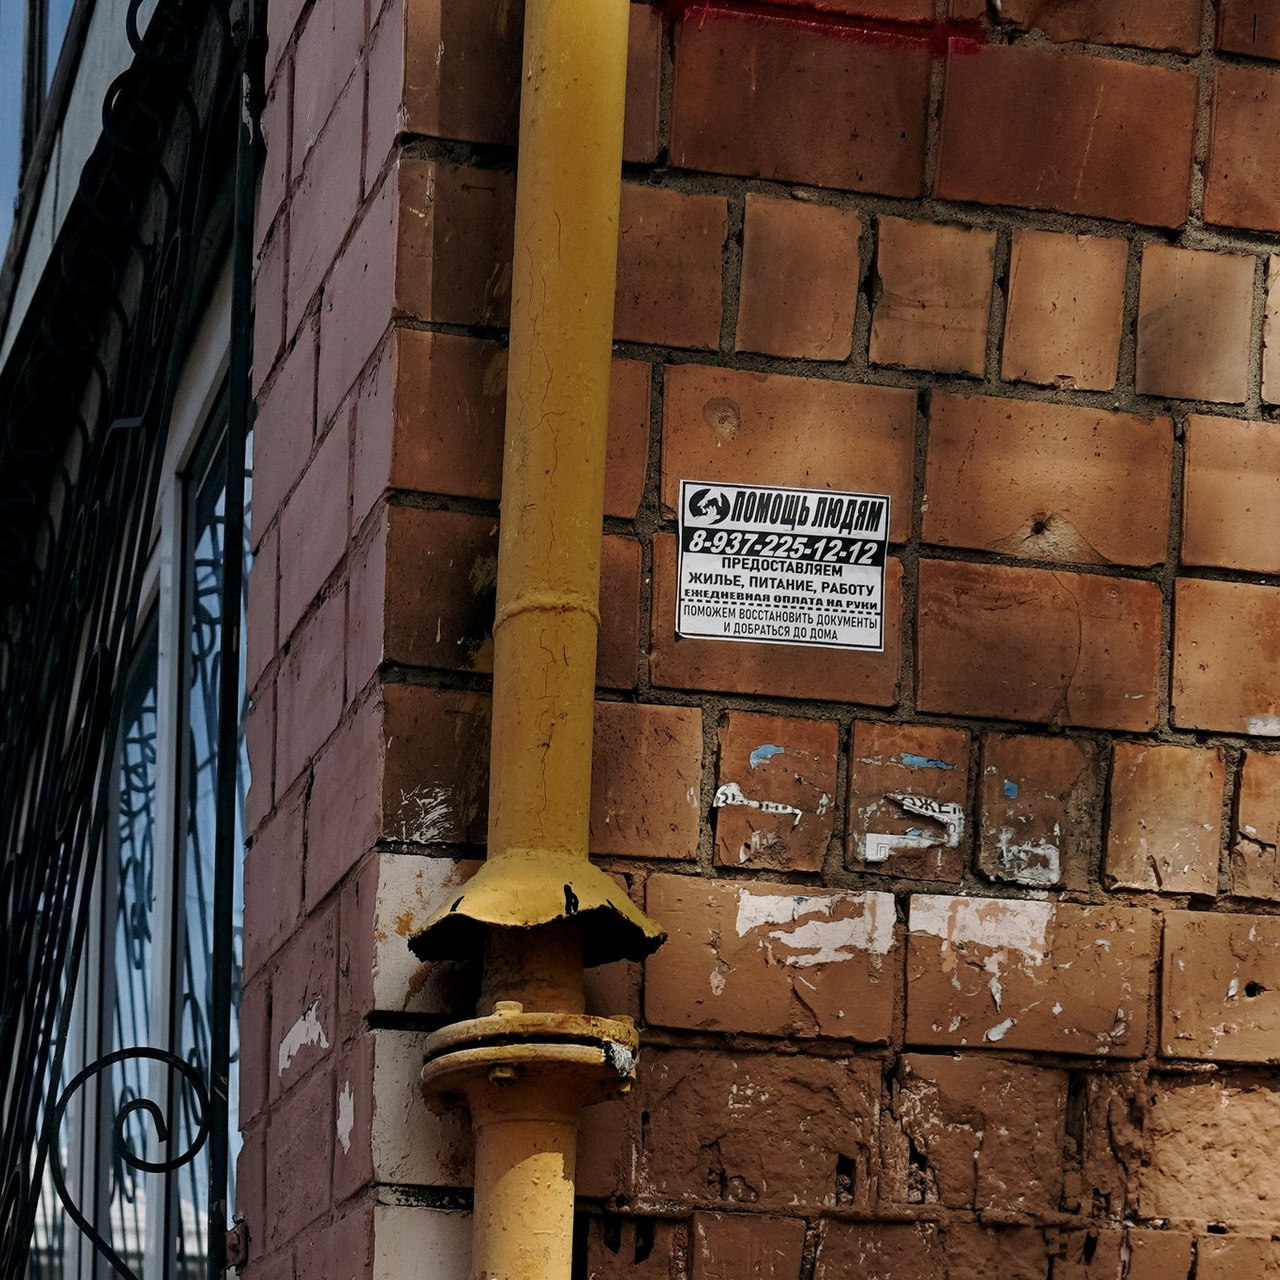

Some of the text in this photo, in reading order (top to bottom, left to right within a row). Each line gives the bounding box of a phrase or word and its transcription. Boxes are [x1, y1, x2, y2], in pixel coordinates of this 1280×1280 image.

[731, 491, 884, 535] ПОМОЩЬ ЛЮДЯМ
[689, 530, 878, 564] 8-937-225-12-12
[722, 557, 843, 577] ПРЕДОСТАВЛЯЕМ
[688, 572, 874, 597] ЖИЛЬЕ, ПИТАНИЕ, РАБОТУ
[684, 588, 878, 610] ЕЖЕДНЕВНАЯ ОПЛАТА НА РУКИ
[683, 604, 878, 629] ПОМОЖЕМ ВОССТАНОВИТЬ ДОКУМЕНТЫ
[723, 622, 838, 640] И ДОБРАТЬСЯ ДО ДОМА
